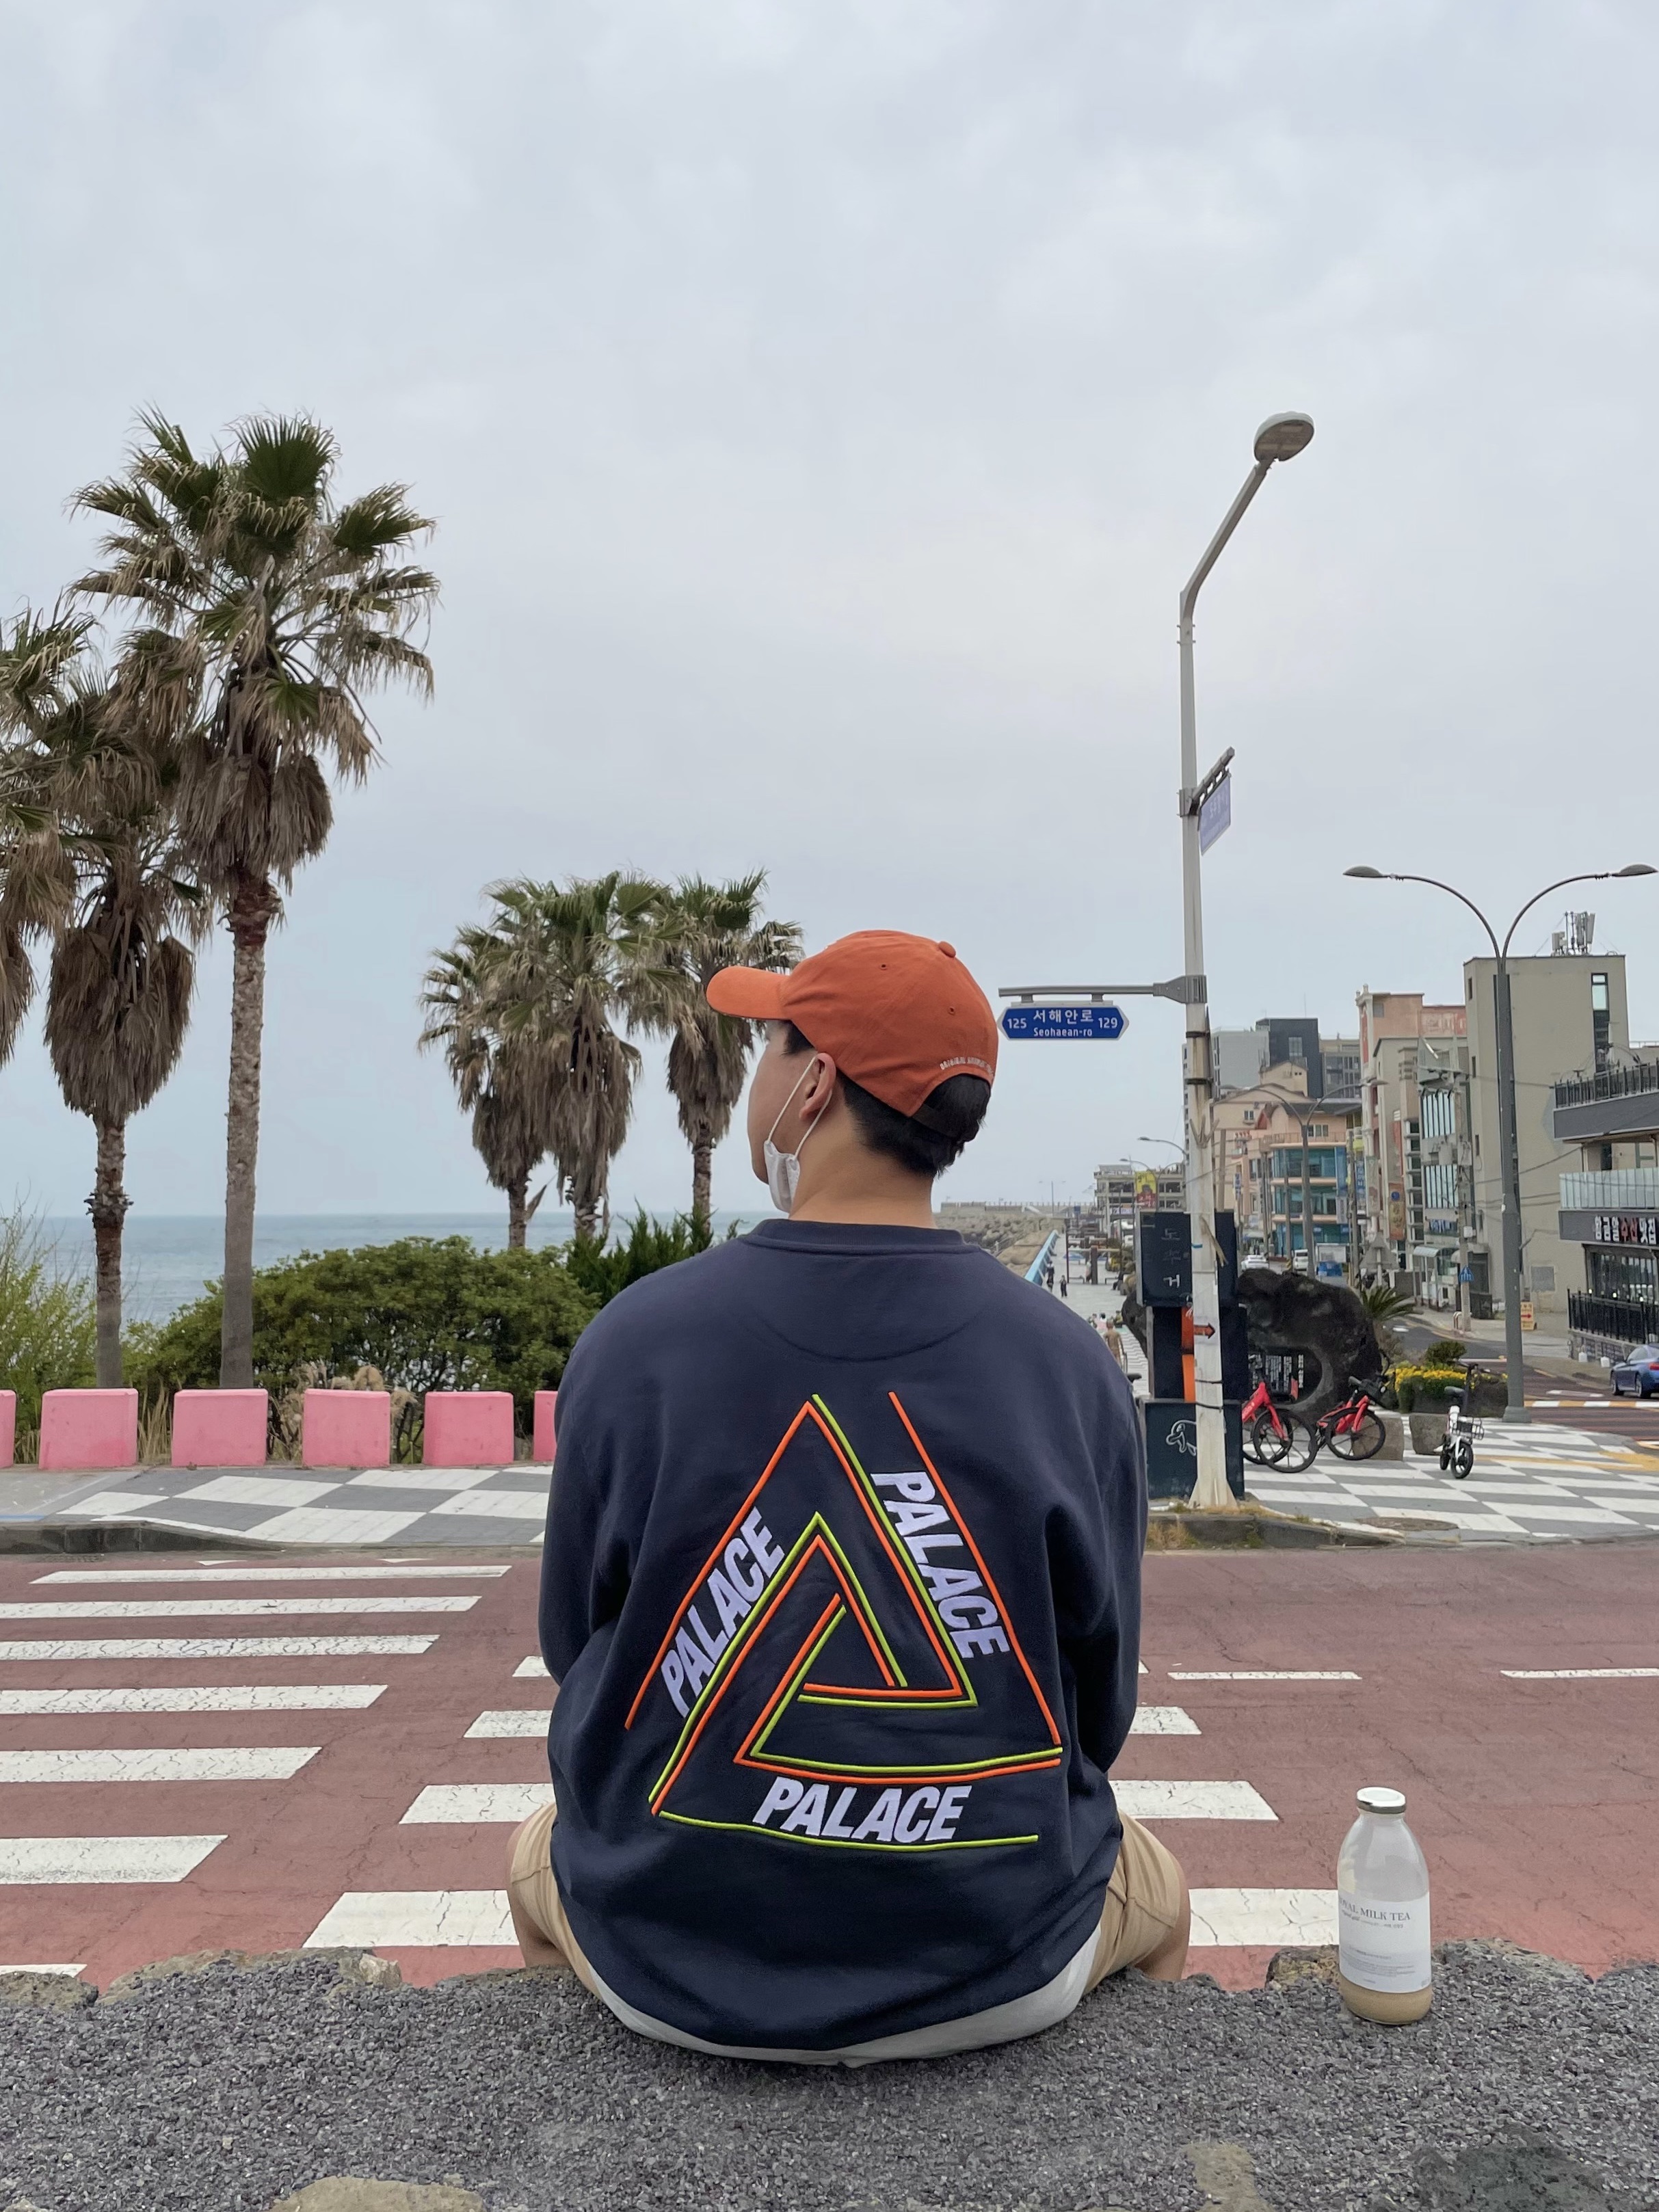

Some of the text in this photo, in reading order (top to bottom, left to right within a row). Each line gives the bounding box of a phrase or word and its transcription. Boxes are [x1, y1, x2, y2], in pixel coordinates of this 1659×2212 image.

[1007, 1018, 1026, 1028] 125
[1033, 1009, 1093, 1024] 서해안로
[1098, 1017, 1117, 1028] 129
[1033, 1027, 1093, 1037] Seohaean-ro
[870, 1470, 1011, 1660] PALACE
[660, 1506, 785, 1719] PALACE
[752, 1776, 972, 1843] PALACE
[1360, 1907, 1387, 1921] MILK
[1390, 1912, 1411, 1921] TEA
